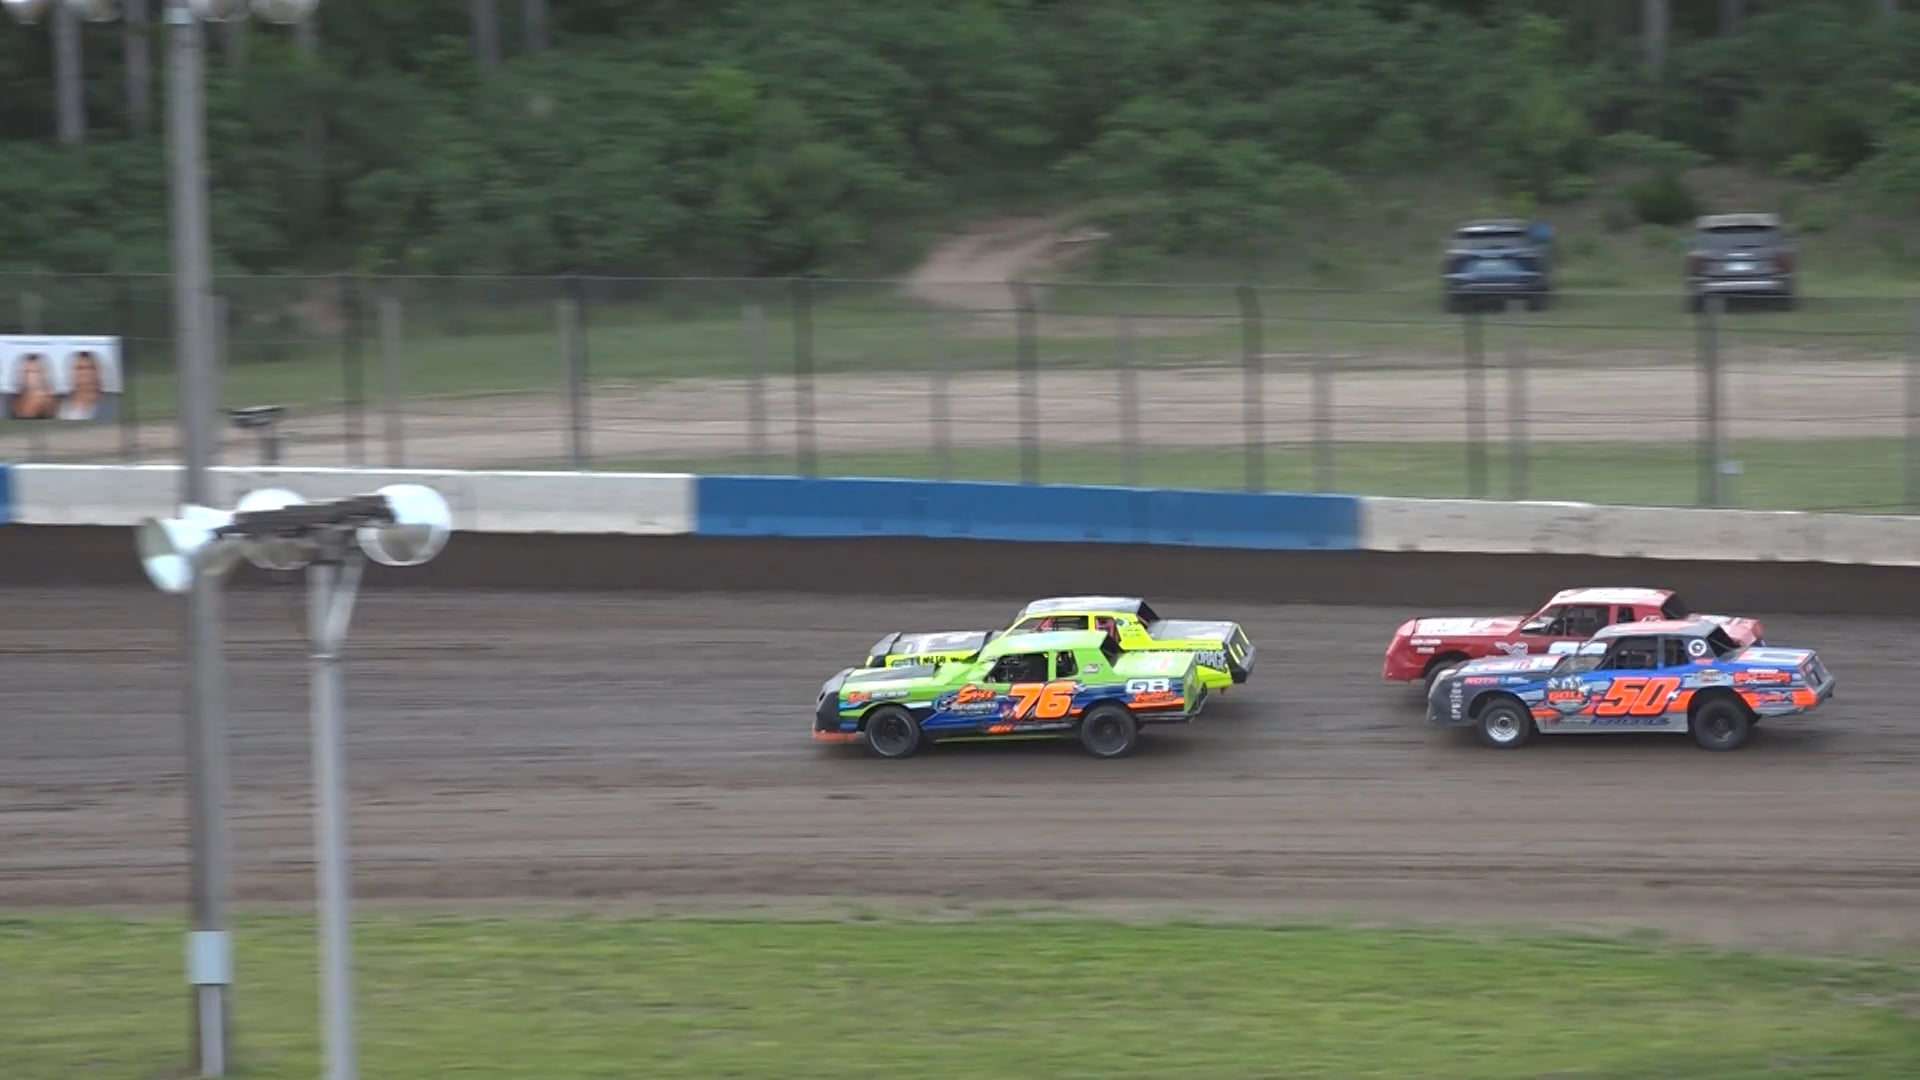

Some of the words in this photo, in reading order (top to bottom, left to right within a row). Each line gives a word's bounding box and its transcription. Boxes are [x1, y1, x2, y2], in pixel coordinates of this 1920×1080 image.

[1009, 680, 1077, 719] 76
[1126, 679, 1169, 693] GB
[1595, 676, 1682, 716] 50
